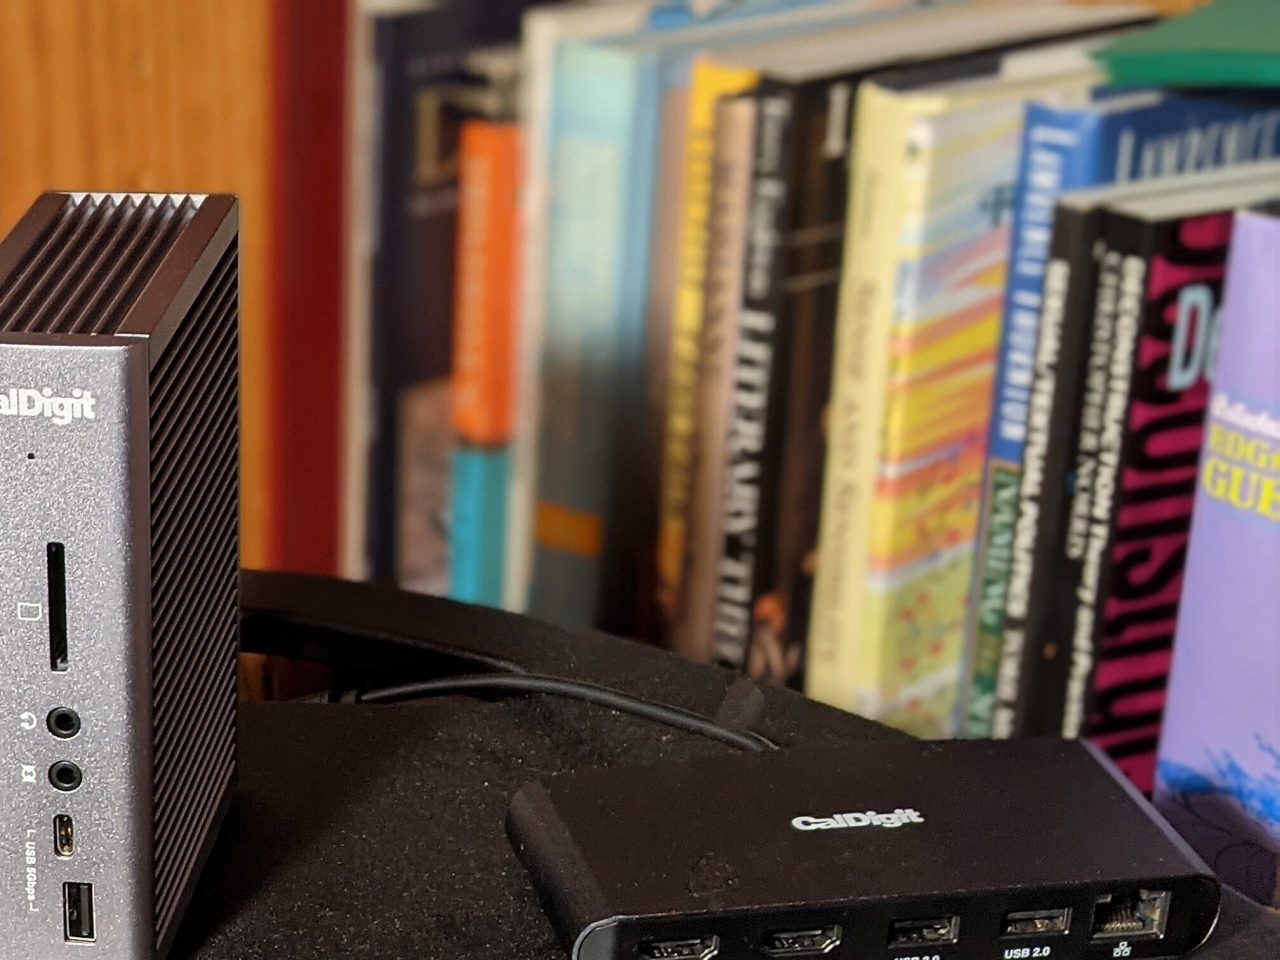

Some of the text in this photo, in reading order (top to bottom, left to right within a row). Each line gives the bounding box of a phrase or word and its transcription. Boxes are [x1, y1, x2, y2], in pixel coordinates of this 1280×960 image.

[1089, 254, 1146, 522] DECONSTRUCTION
[1203, 456, 1280, 522] GUE
[791, 808, 924, 831] CalDigit
[25, 841, 37, 900] USB 5Gbps
[1004, 946, 1051, 960] USB 2.0
